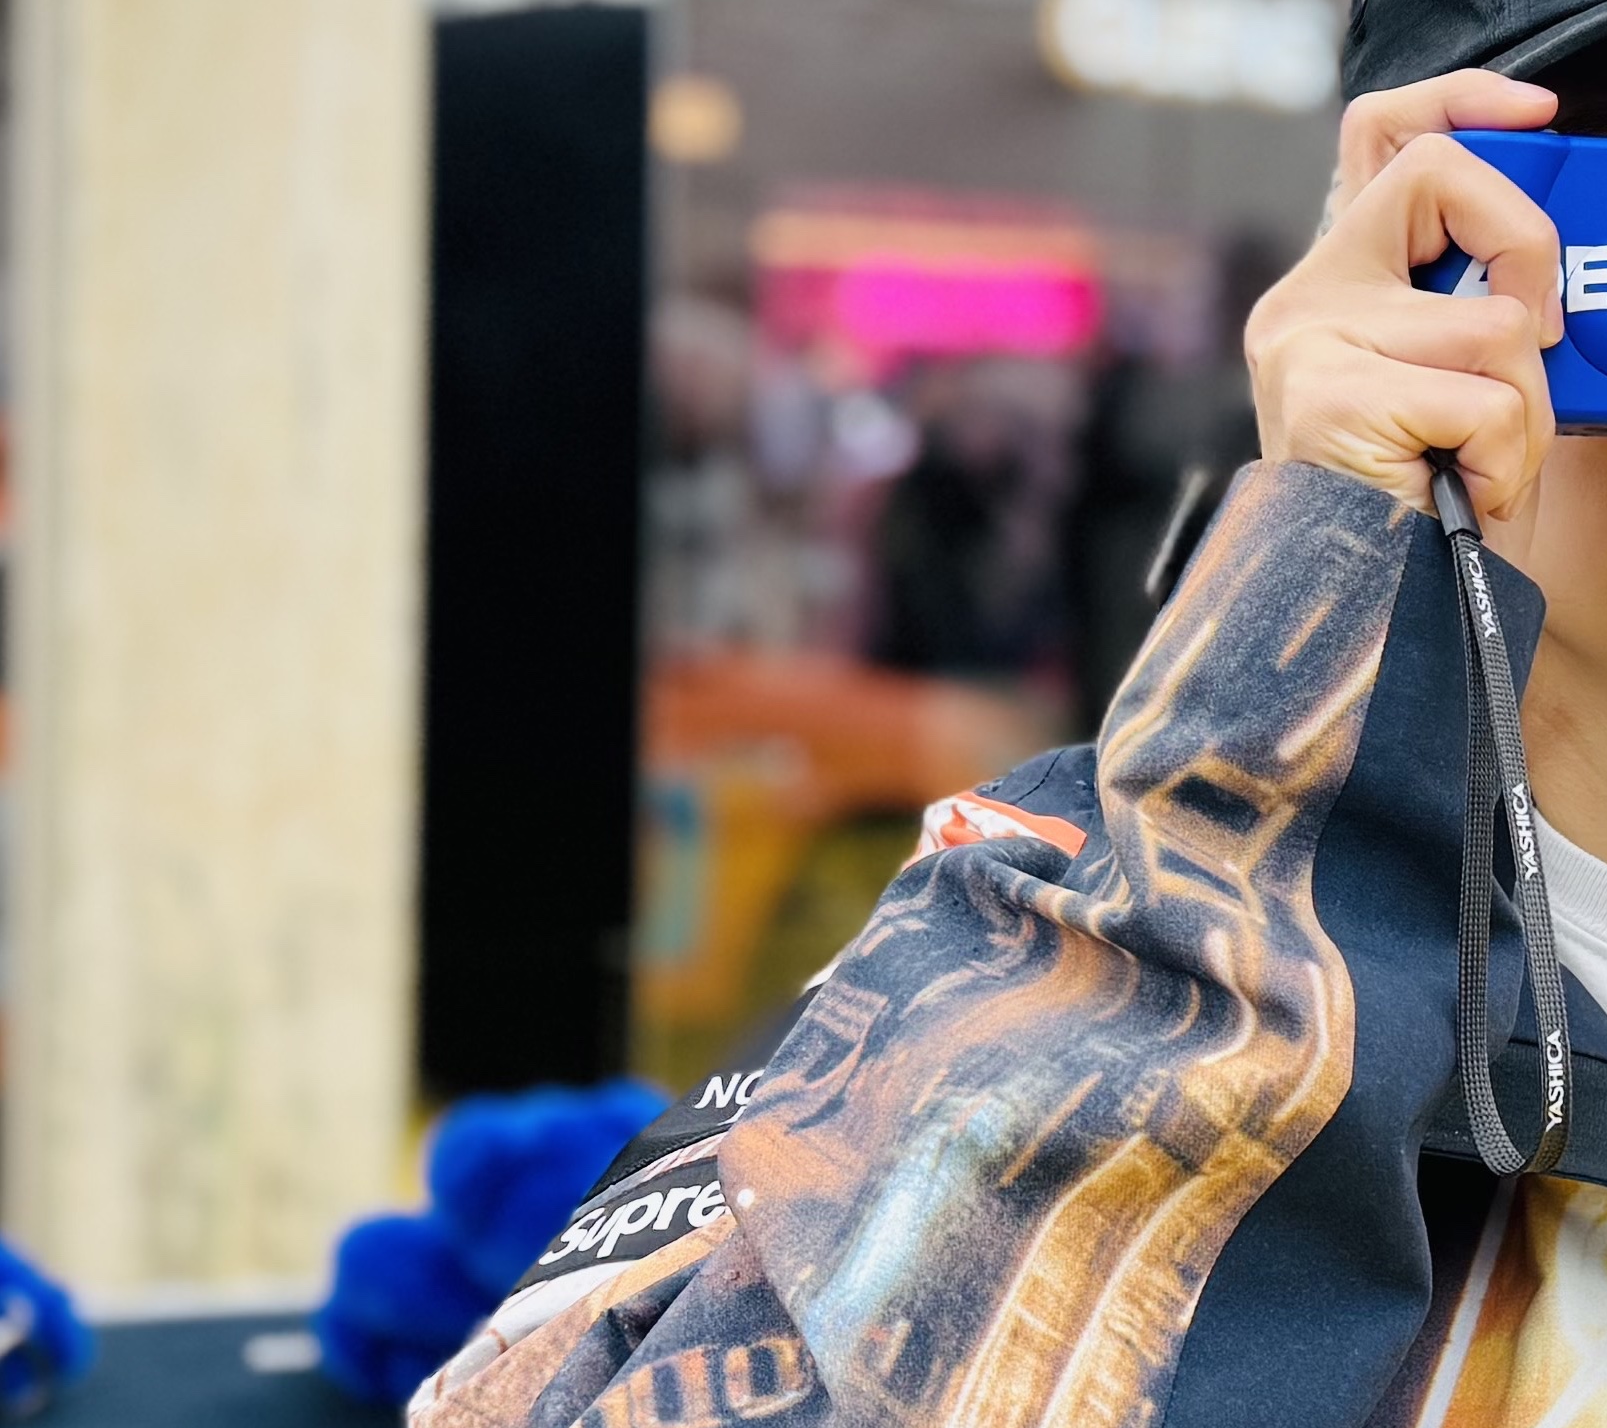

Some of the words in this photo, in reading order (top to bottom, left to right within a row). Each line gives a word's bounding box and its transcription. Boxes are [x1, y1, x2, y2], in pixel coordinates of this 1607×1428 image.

[1467, 550, 1497, 639] YASHICA
[1514, 782, 1539, 880] YASHICA
[1546, 1030, 1562, 1133] YASHICA
